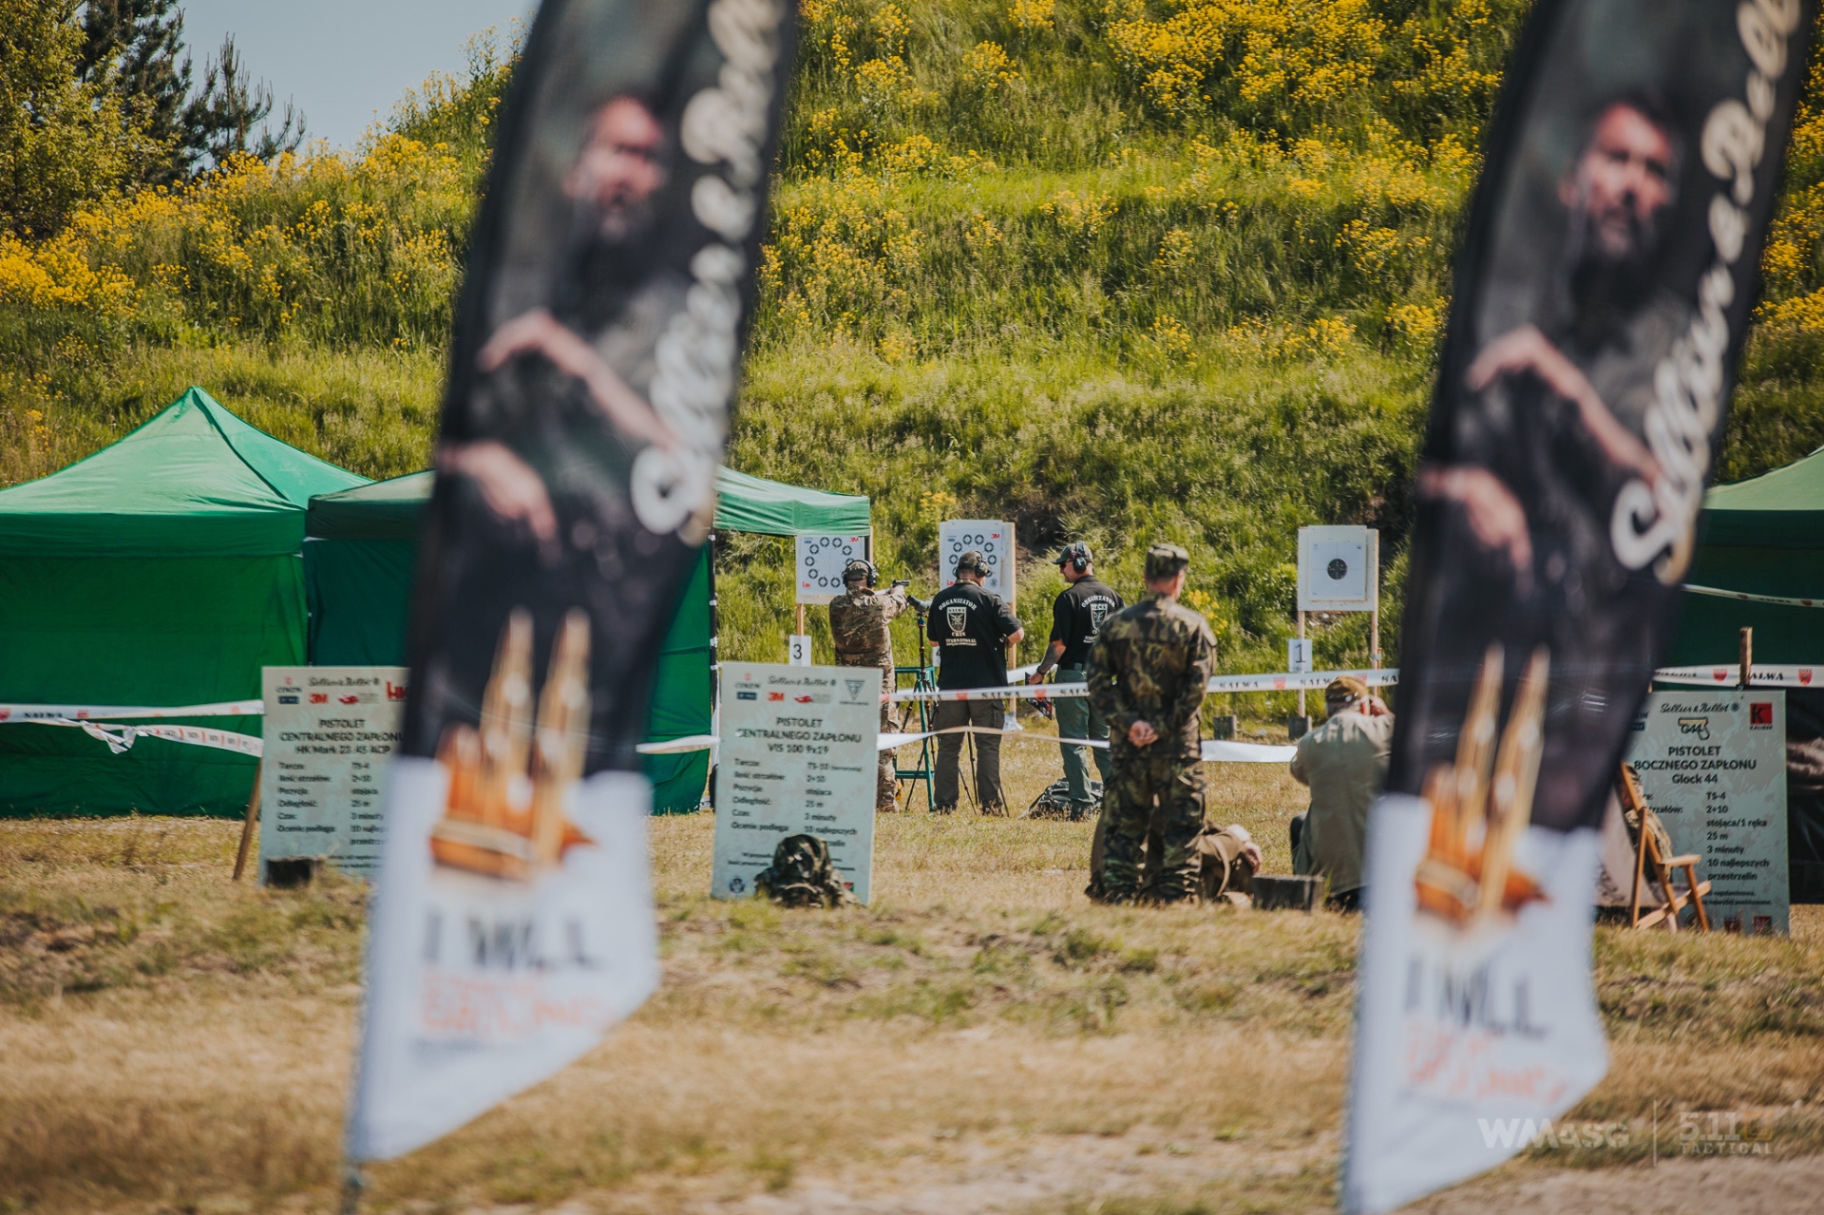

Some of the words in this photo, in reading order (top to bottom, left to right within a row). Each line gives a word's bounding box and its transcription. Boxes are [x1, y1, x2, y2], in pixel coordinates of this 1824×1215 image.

[938, 598, 977, 610] ORGANIZATOR
[793, 643, 803, 660] 3
[1294, 643, 1306, 663] 1
[1749, 672, 1784, 681] ALWA
[1219, 681, 1259, 689] SALWA
[1300, 678, 1331, 686] SALW
[767, 692, 785, 702] 3M
[1660, 703, 1692, 713] Sellier
[1699, 702, 1730, 712] Bellot
[319, 718, 365, 728] PISTOLET
[776, 717, 823, 728] PISTOLET
[280, 732, 354, 741] CENTRALNEGO
[813, 732, 862, 743] ZAPŁONU
[767, 743, 784, 753] VIS
[1668, 746, 1721, 756] PISTOLET
[1634, 760, 1698, 770] BOCZNEGO
[1700, 759, 1757, 770] ZAPŁONU
[1671, 773, 1702, 784] Glock
[1704, 773, 1719, 783] 44
[1706, 792, 1726, 800] TS-4
[1649, 805, 1683, 813] trzałów:
[1706, 805, 1728, 813] 2+10
[1706, 832, 1718, 840] 25
[1706, 845, 1713, 854] 3
[1714, 845, 1745, 855] minuty
[1707, 859, 1718, 867] 10
[1719, 858, 1770, 868] najlepszych
